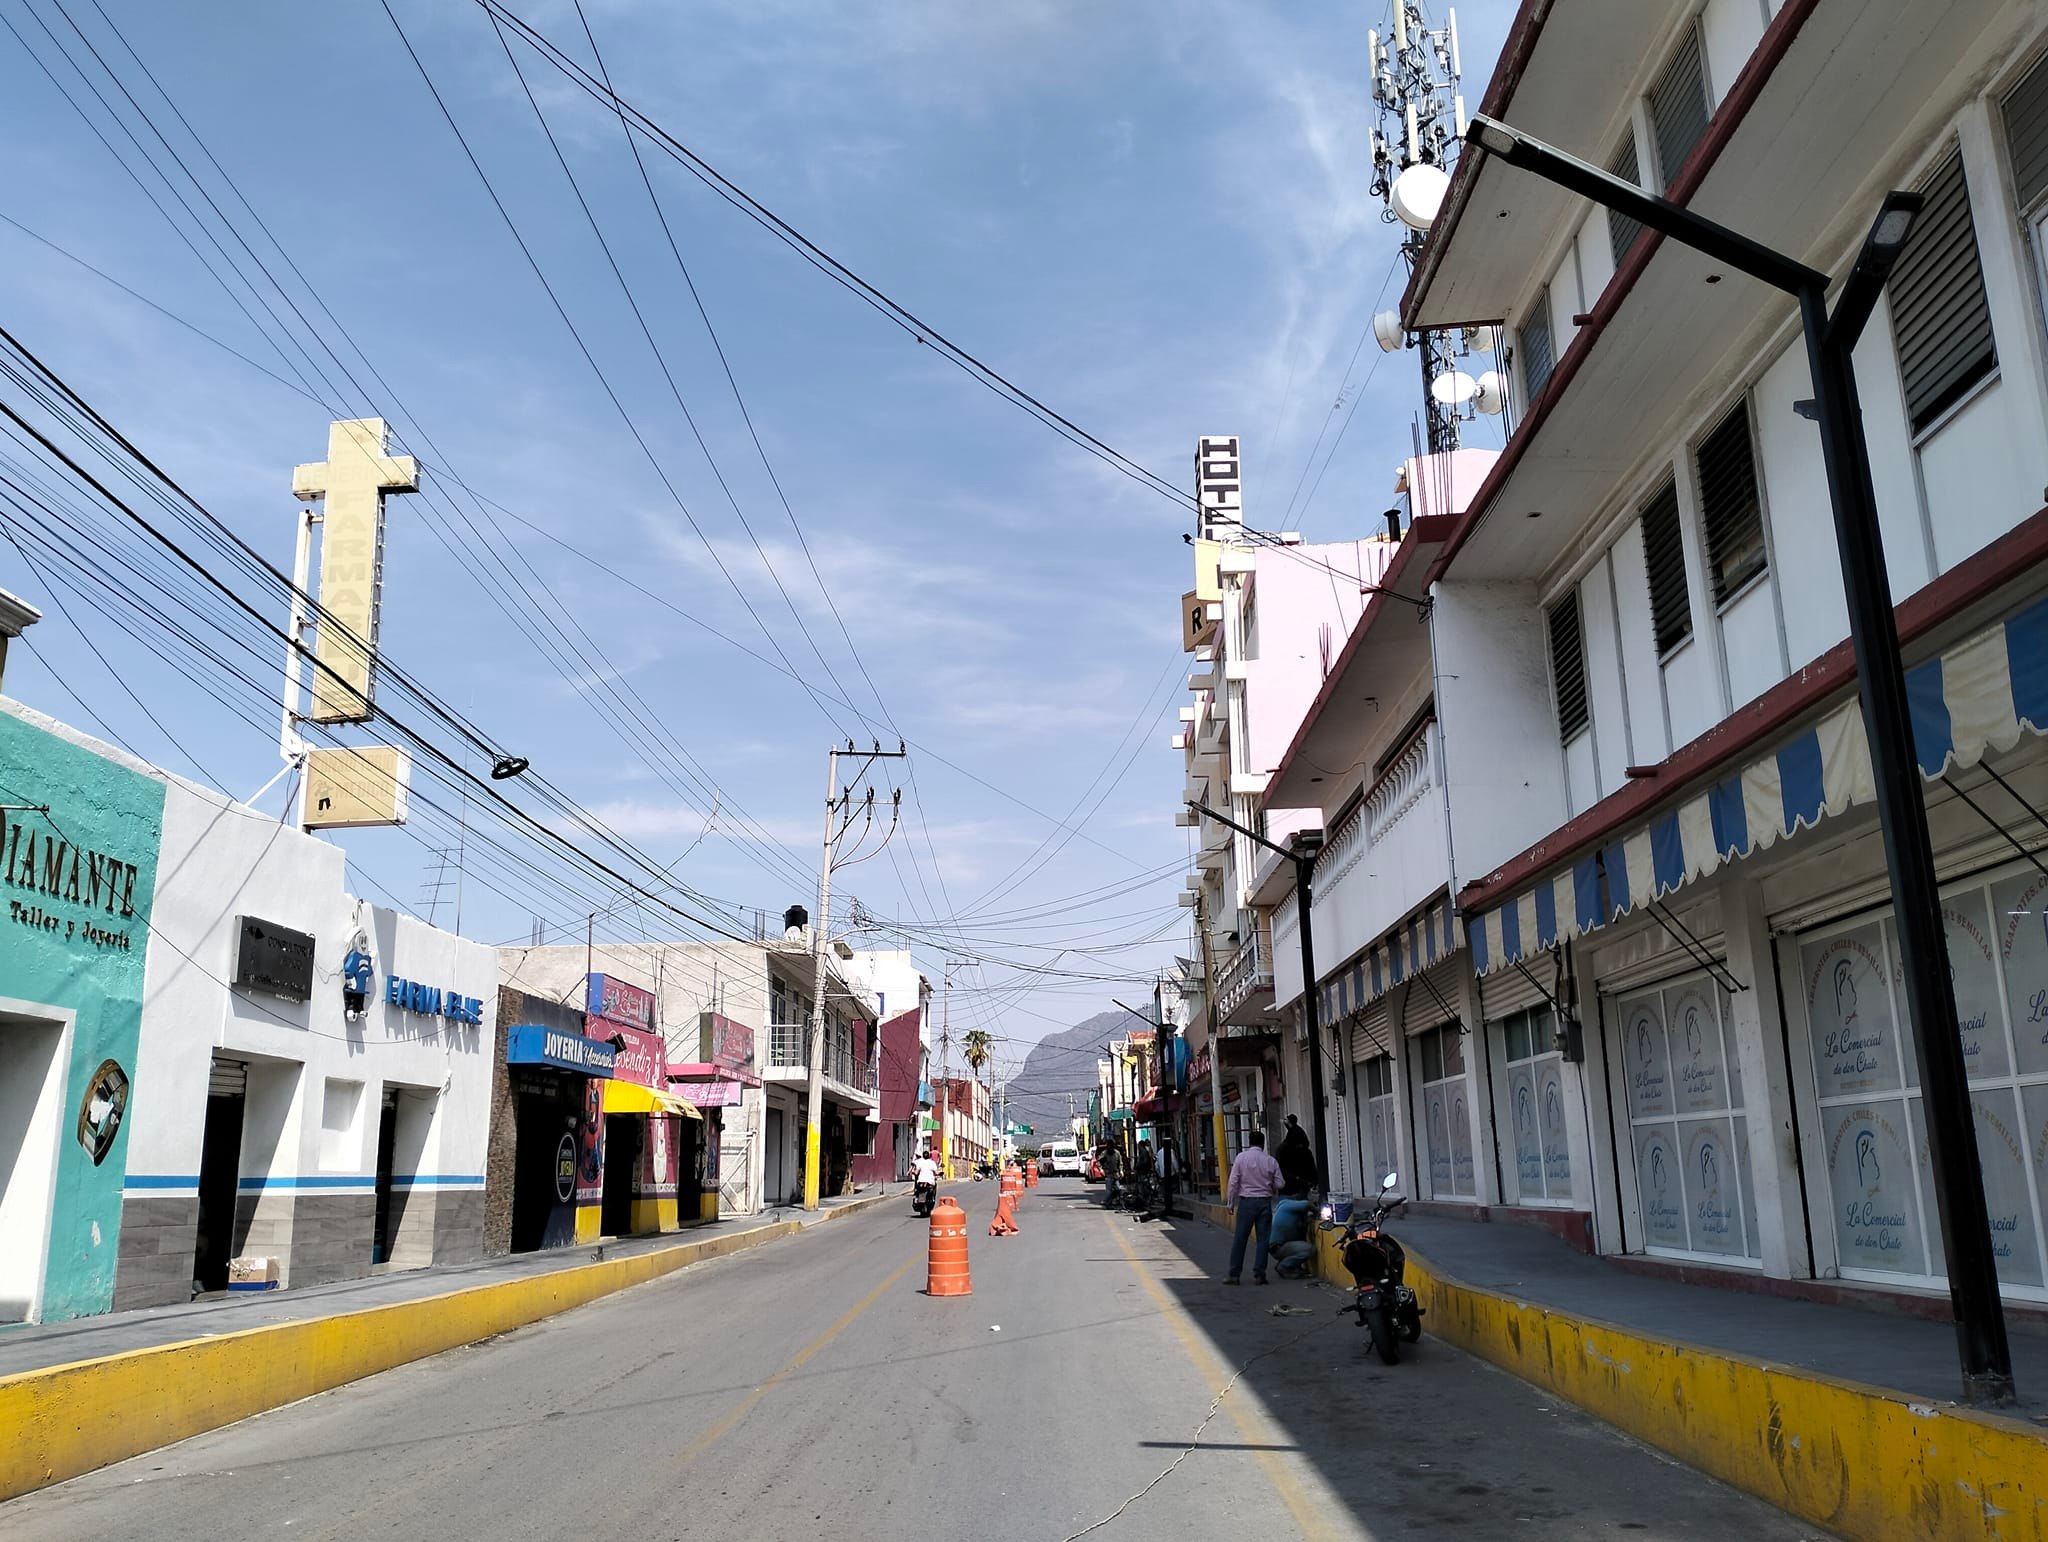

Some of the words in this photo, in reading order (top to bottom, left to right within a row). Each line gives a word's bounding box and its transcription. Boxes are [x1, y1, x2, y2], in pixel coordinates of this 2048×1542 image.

[1202, 438, 1240, 542] HOTEL
[0, 808, 137, 918] IAMANTE
[10, 900, 59, 931] Taller
[65, 920, 76, 940] y
[385, 974, 442, 1015] FARMA
[444, 990, 483, 1026] BLUE
[1958, 1012, 1986, 1032] ercial
[544, 1031, 583, 1064] JOYERIA
[1824, 1031, 1839, 1058] La
[1840, 1028, 1882, 1054] Comercial
[1846, 1202, 1860, 1228] La
[1862, 1201, 1906, 1227] Comercial
[1989, 1214, 2018, 1233] ercial
